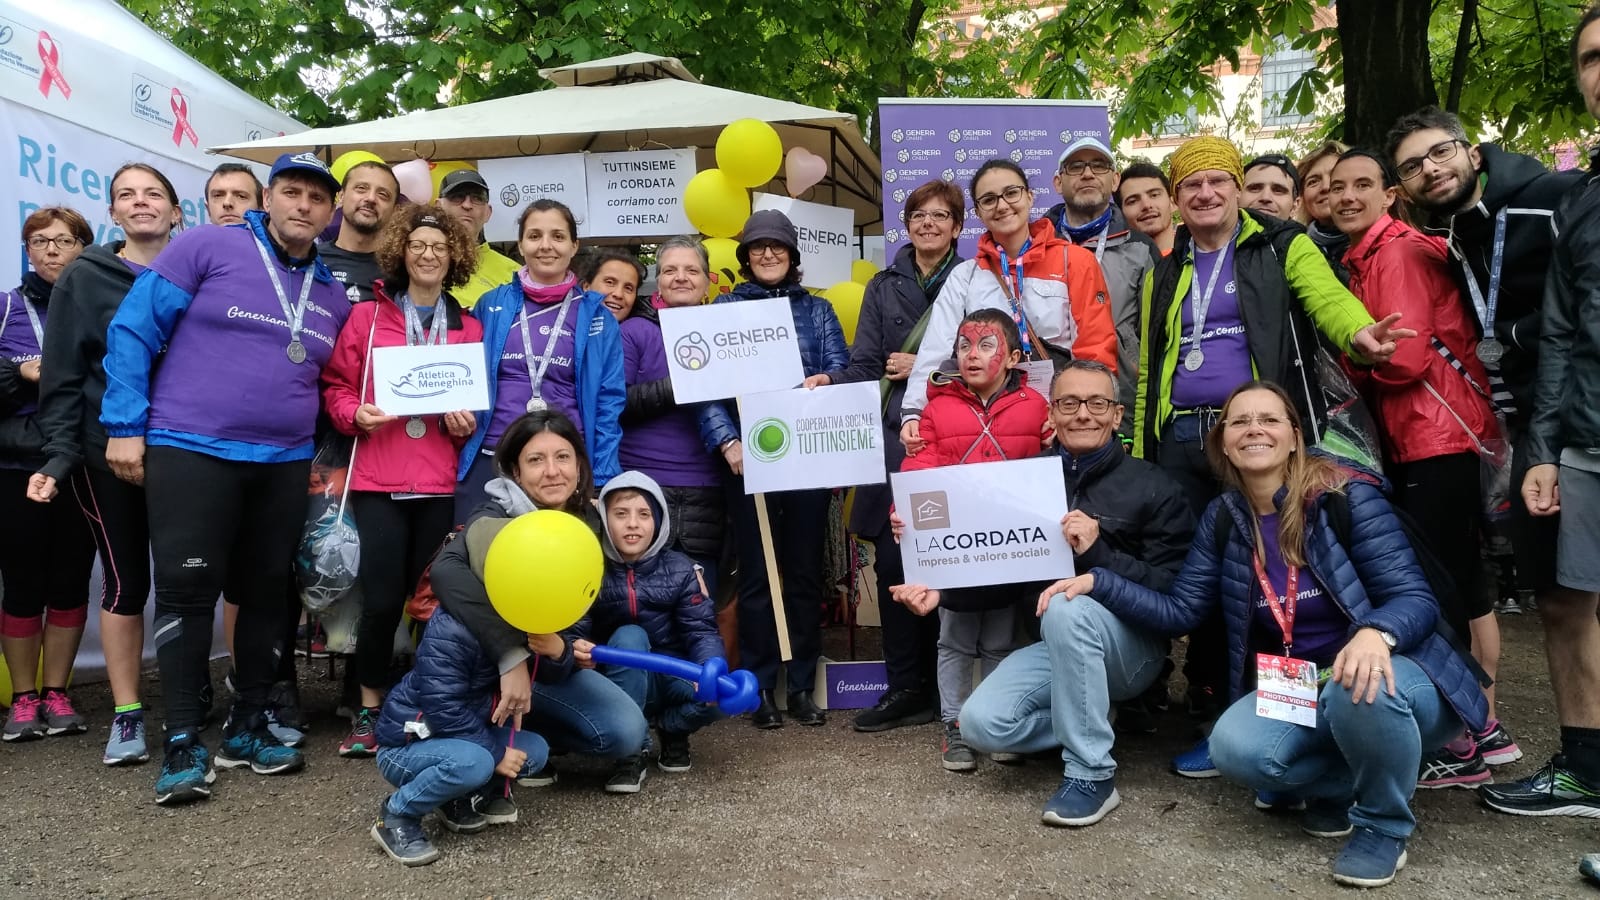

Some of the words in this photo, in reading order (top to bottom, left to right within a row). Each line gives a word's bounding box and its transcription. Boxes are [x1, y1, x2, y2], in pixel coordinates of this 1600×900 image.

[602, 160, 676, 172] TUTTINSIEME
[522, 182, 564, 194] GENERA
[608, 180, 617, 189] in
[620, 178, 676, 188] CORDATA
[608, 197, 654, 206] corriamo
[658, 197, 678, 205] con
[617, 214, 668, 224] GENERA!
[797, 242, 820, 254] NLUS
[228, 306, 290, 327] Generiam
[713, 326, 789, 346] GENERA
[1216, 325, 1246, 336] comu
[716, 346, 758, 360] ONLUS
[418, 370, 456, 380] Atletica
[418, 378, 474, 388] Meneghina
[796, 415, 844, 432] COOPERATIVA
[844, 412, 874, 428] SOCIALE
[796, 428, 876, 454] TUTTINSIEME
[918, 557, 960, 568] impresa
[962, 554, 970, 563] &
[973, 551, 1008, 562] valore
[1010, 547, 1050, 559] sociale
[837, 680, 890, 694] Generiamo
